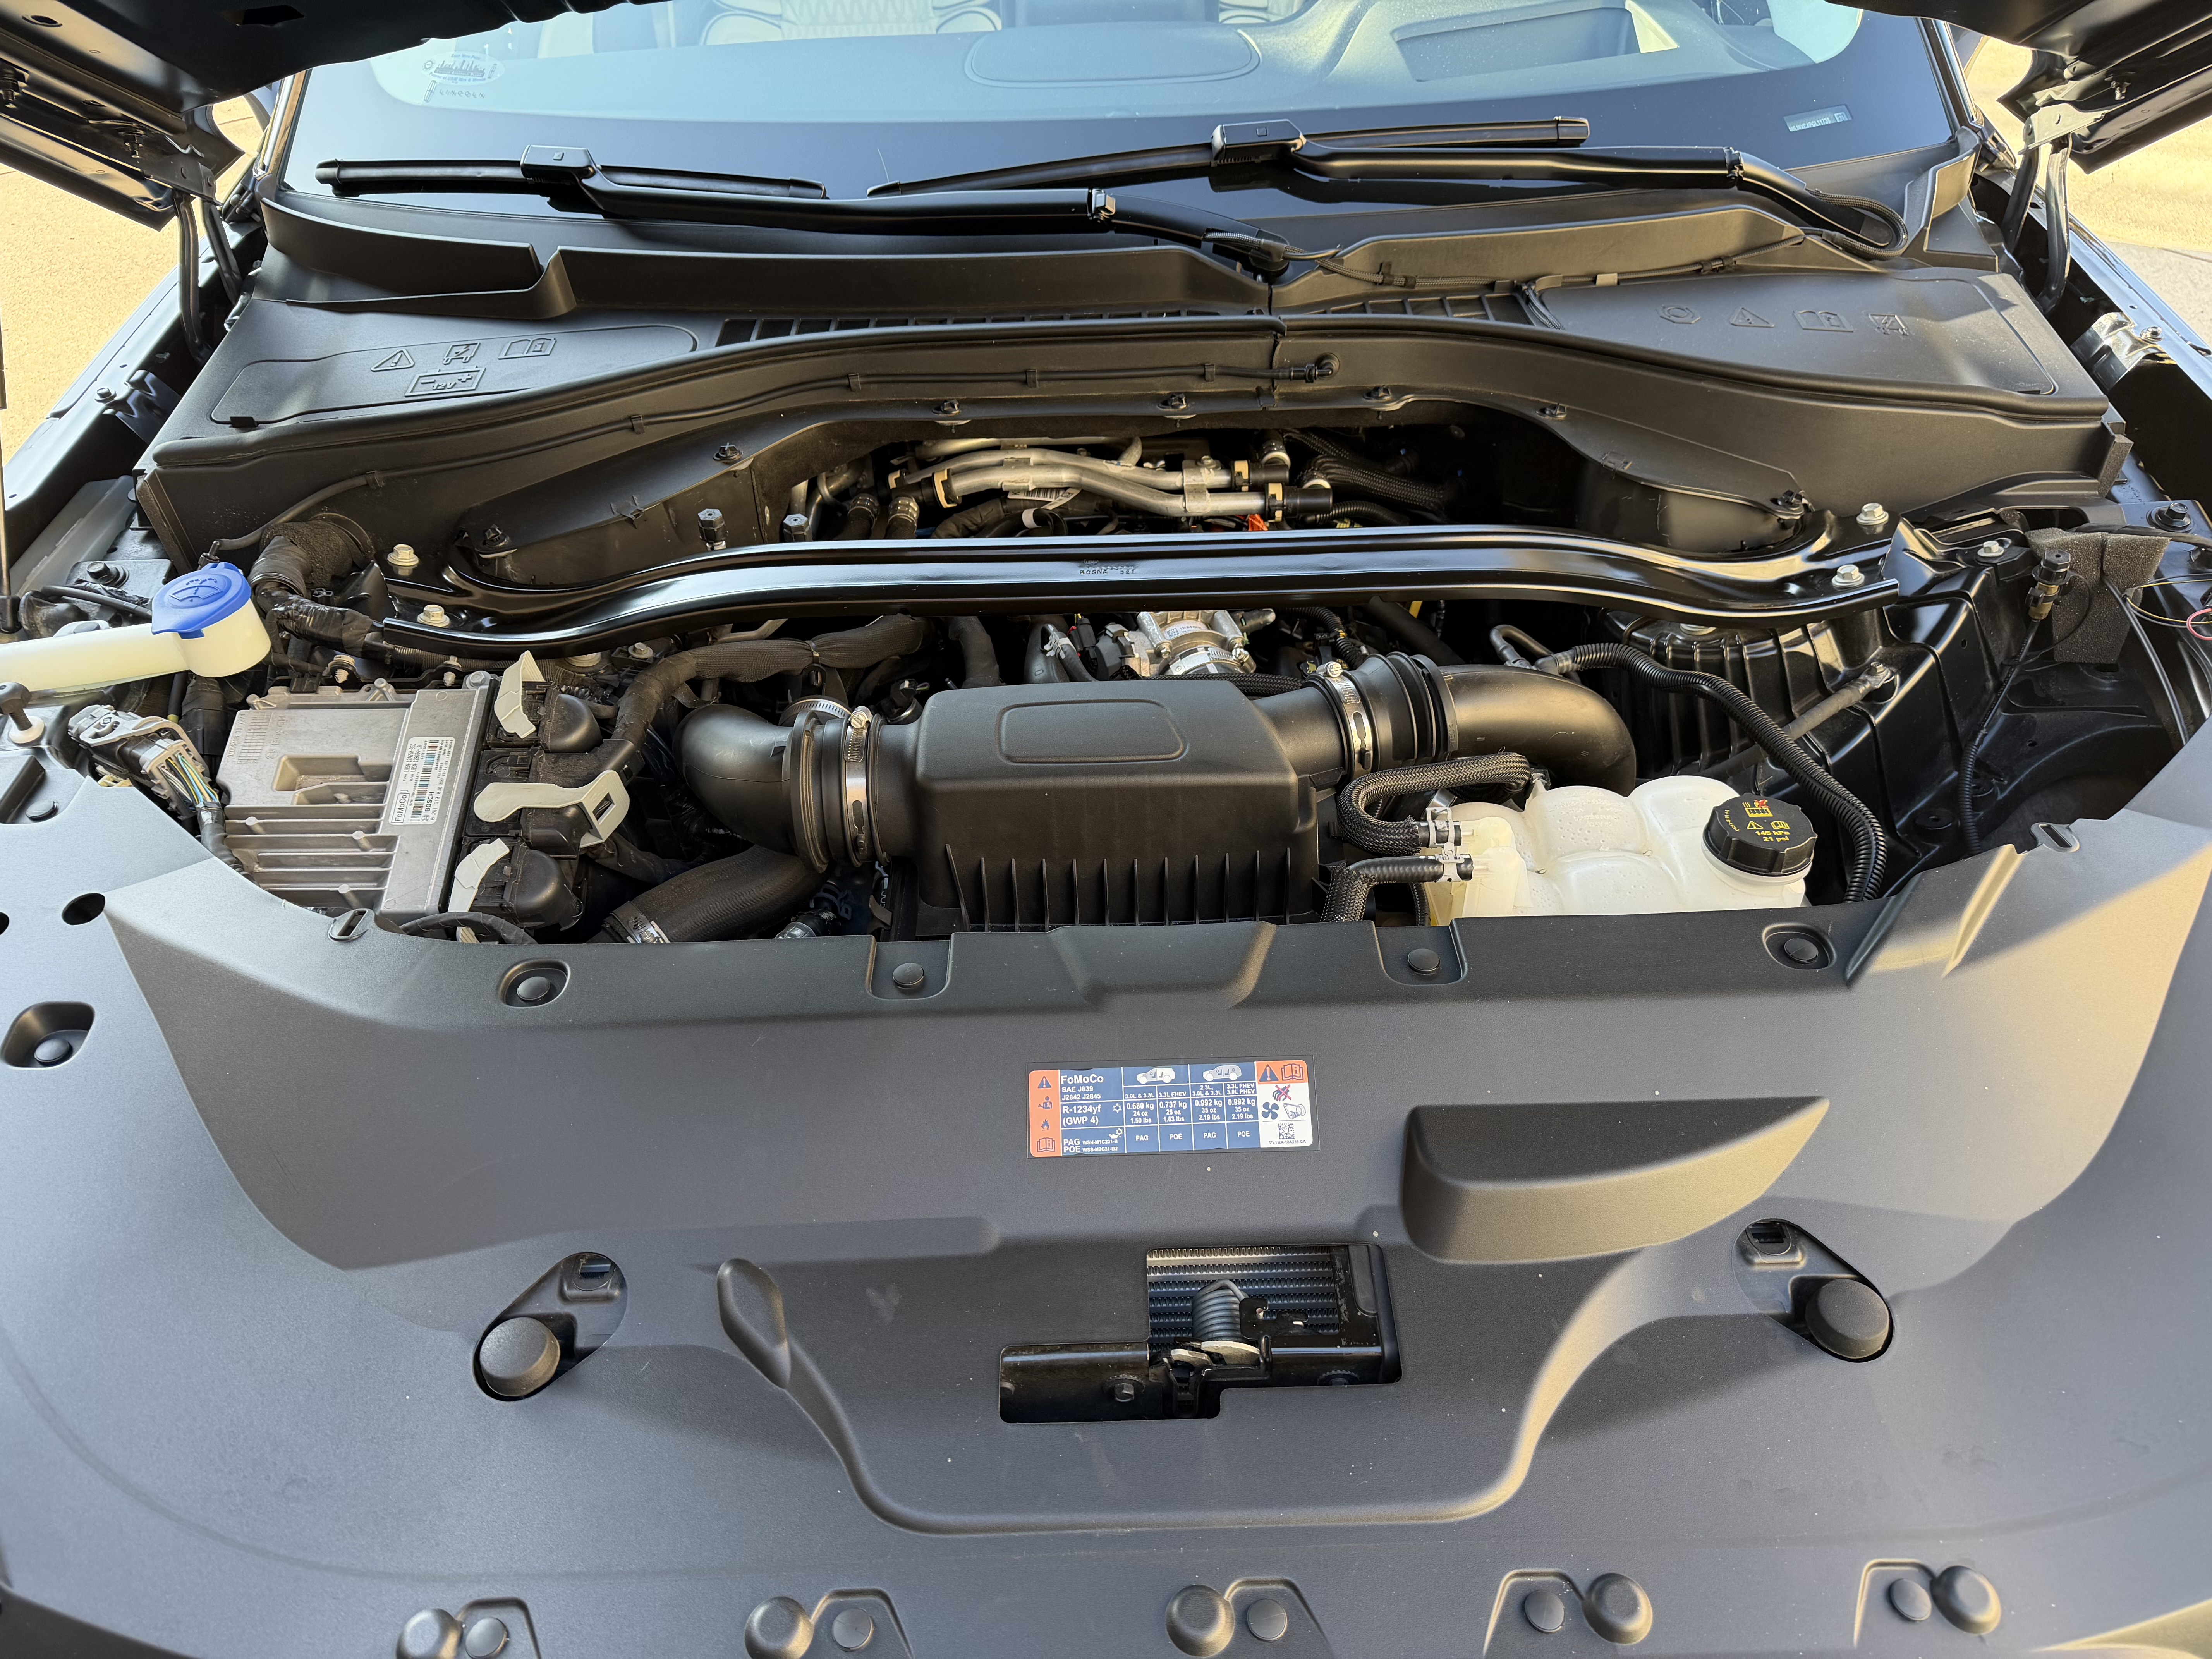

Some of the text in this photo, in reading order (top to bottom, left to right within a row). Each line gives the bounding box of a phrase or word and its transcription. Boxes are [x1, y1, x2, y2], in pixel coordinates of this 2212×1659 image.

[432, 381, 457, 390] 12V
[424, 792, 434, 811] BOSCH
[394, 795, 407, 821] FoMoCo
[1061, 1074, 1104, 1084] FoMoCo
[1146, 1102, 1154, 1110] kg
[1178, 1101, 1187, 1109] kg
[1214, 1099, 1222, 1107] kg
[1062, 1104, 1101, 1115] R-1234yf
[1063, 1116, 1099, 1127] (GWP 4)
